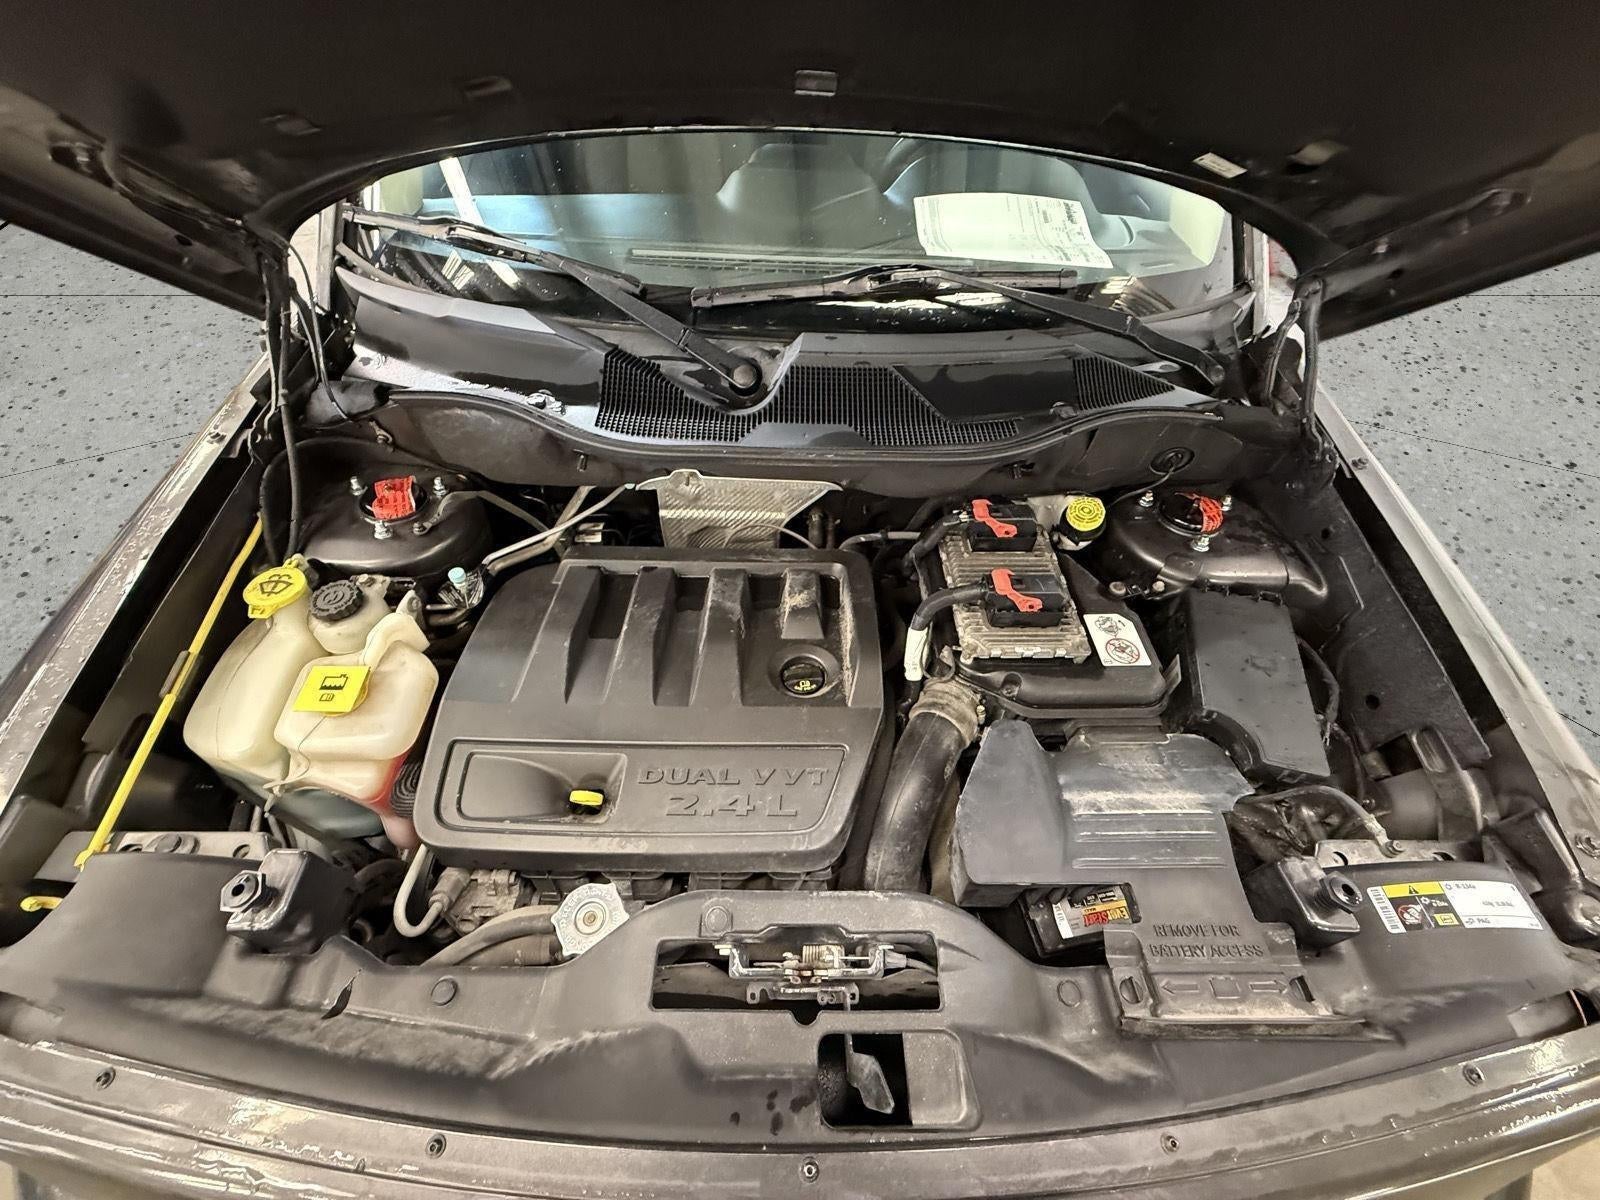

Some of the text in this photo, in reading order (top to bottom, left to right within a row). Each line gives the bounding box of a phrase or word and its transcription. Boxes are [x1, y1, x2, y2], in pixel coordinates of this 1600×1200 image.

[637, 767, 830, 786] DUAL VVT
[666, 794, 798, 817] 2.4L
[1153, 924, 1241, 937] REMOVE FOR
[1149, 944, 1264, 958] BATTERY ACCESS
